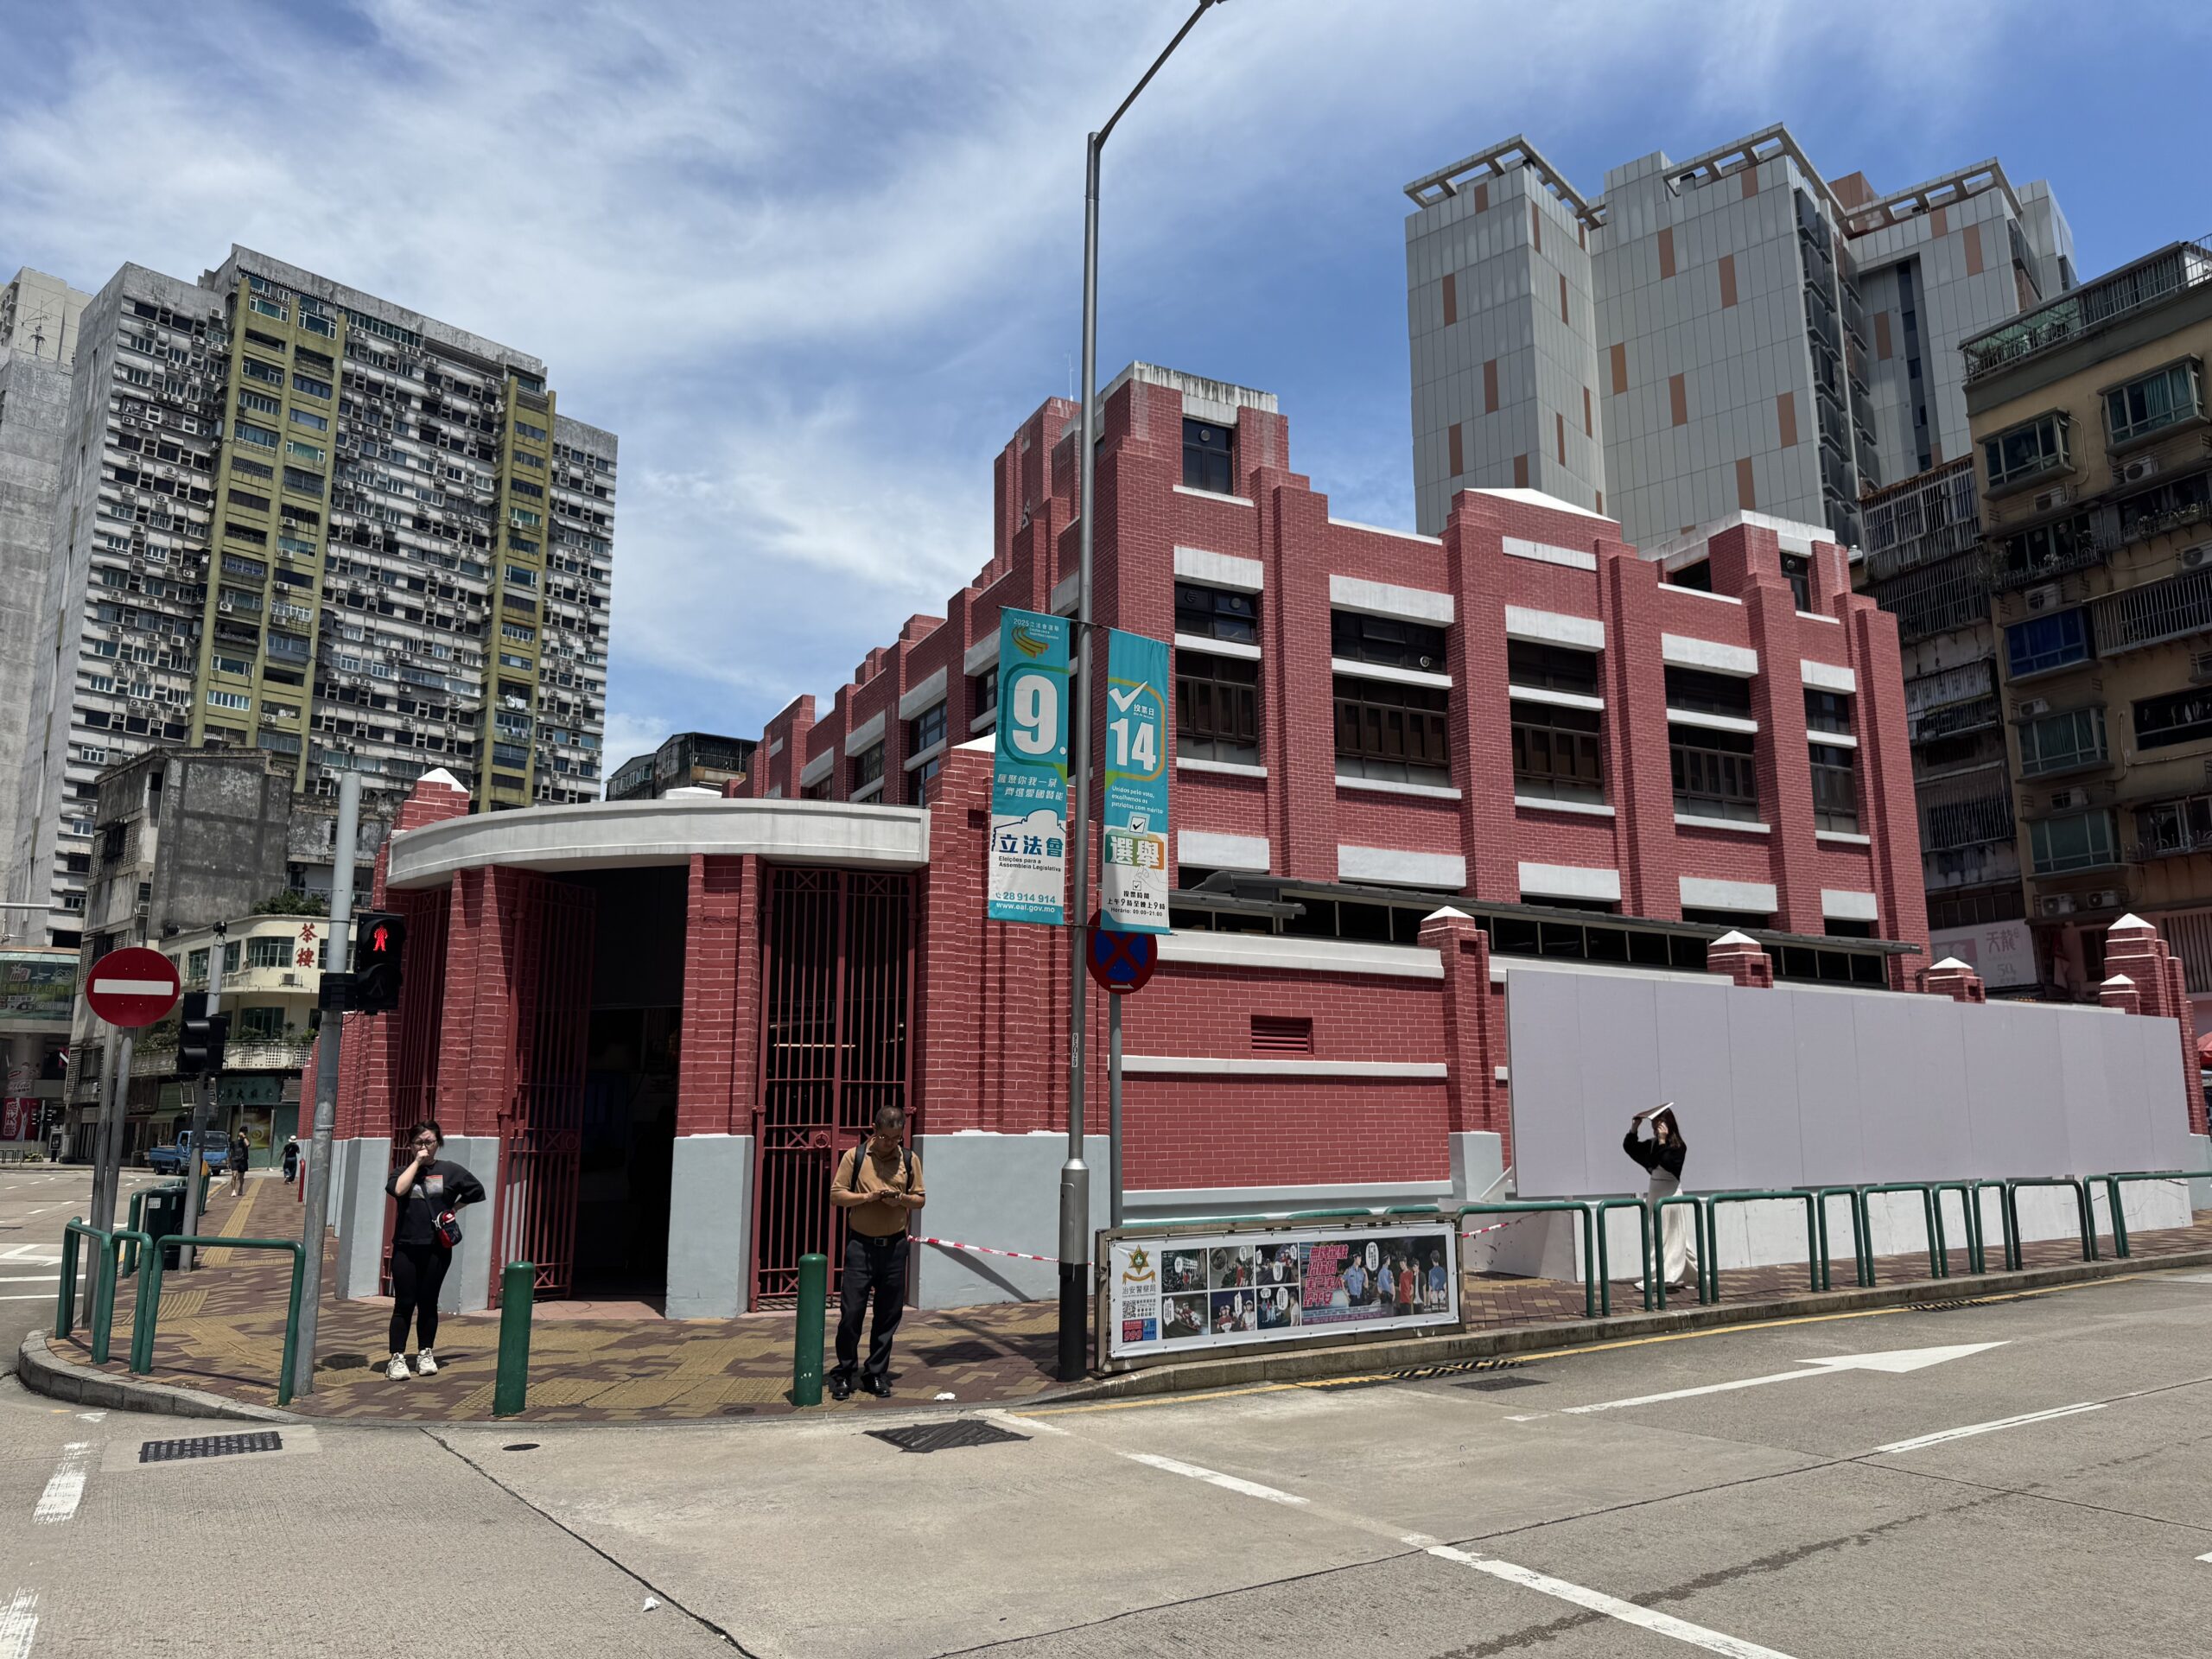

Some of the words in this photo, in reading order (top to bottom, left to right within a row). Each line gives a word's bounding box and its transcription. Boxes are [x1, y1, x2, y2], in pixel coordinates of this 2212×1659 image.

[1134, 703, 1154, 716] 投票日
[1109, 717, 1156, 772] 14
[1111, 785, 1130, 794] Unidos
[1130, 787, 1142, 797] pelo
[1111, 793, 1141, 804] escolhemos
[1111, 800, 1134, 810] patriotas
[1147, 805, 1164, 815] mérito
[999, 834, 1064, 858] 立法會
[1109, 836, 1160, 868] 選舉
[1003, 892, 1015, 900] 28
[1017, 893, 1035, 902] 914
[1038, 894, 1056, 904] 914
[1123, 890, 1150, 899] 投票時間
[996, 902, 1056, 913] www.eal.gov.mo
[1107, 898, 1166, 911] 上午9時至晚上9時
[296, 922, 318, 968] 茶樓
[1986, 929, 2017, 954] 天龍
[1310, 1244, 1349, 1261] 無牌駕駛
[1122, 1284, 1156, 1294] 治安警察局
[1305, 1275, 1344, 1292] 害己害人
[1124, 1330, 1142, 1342] 999
